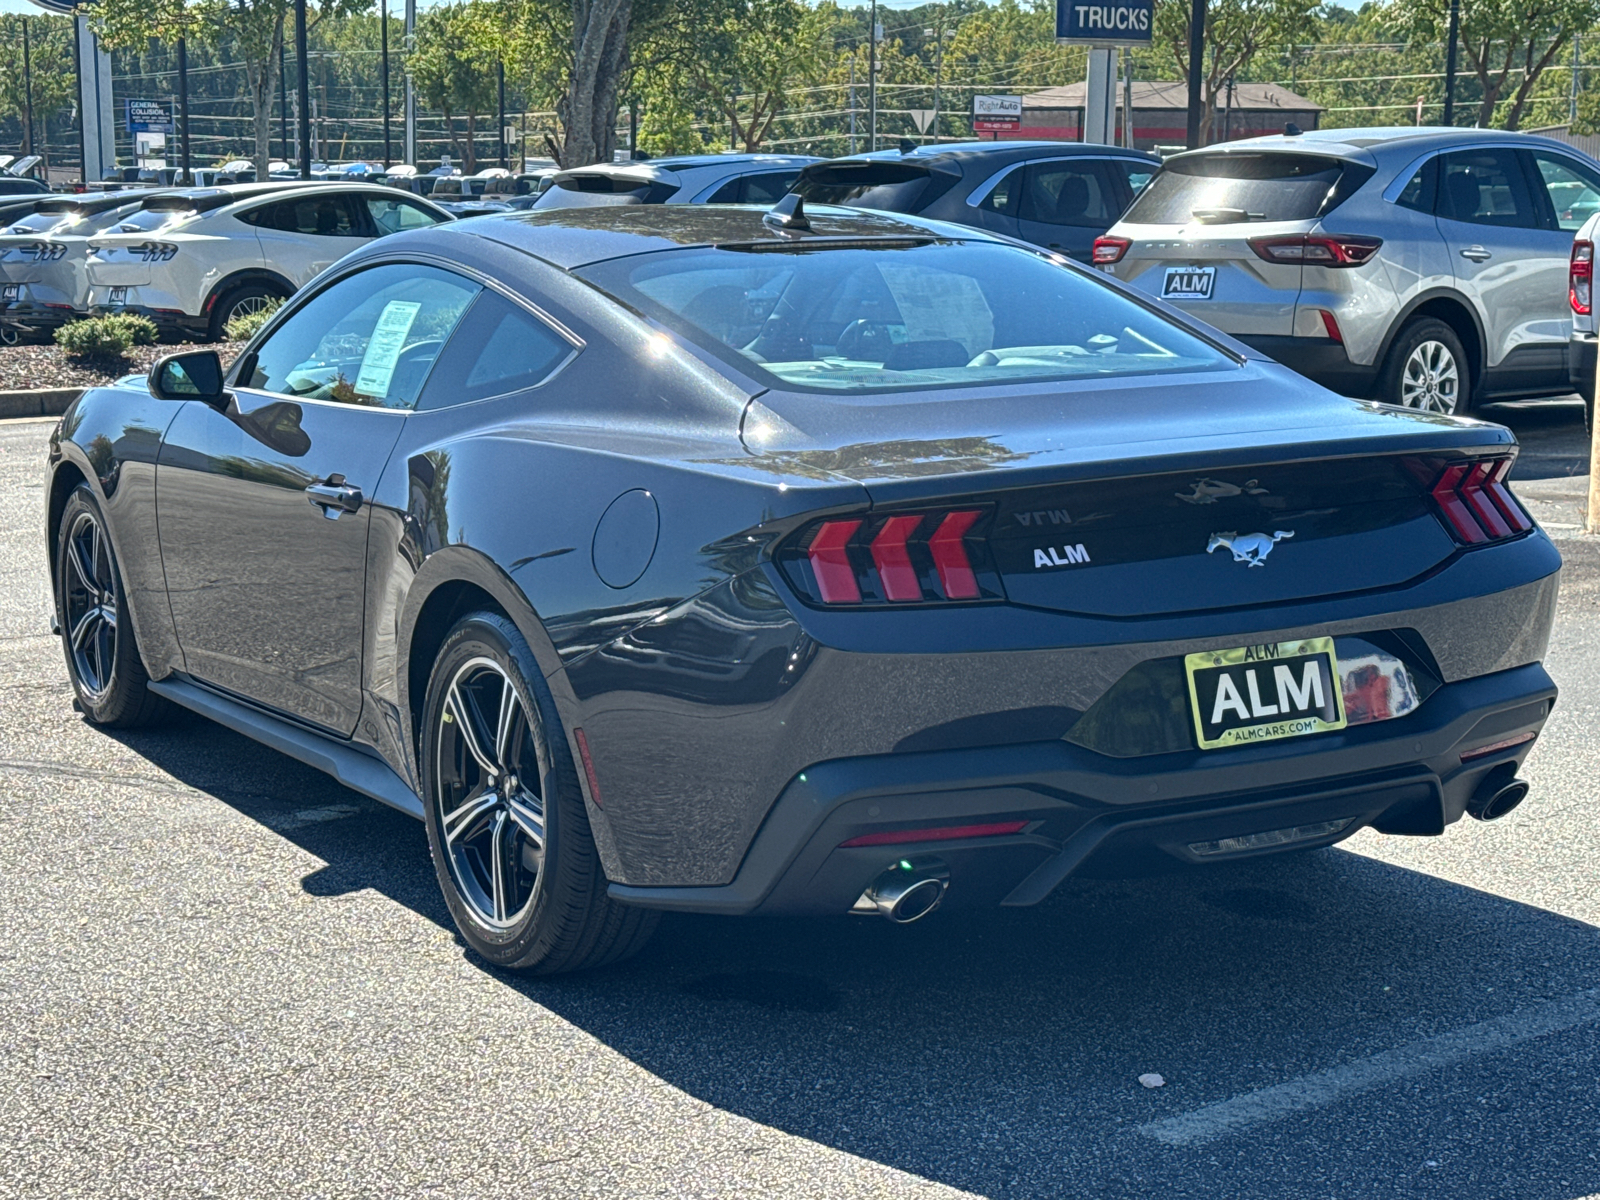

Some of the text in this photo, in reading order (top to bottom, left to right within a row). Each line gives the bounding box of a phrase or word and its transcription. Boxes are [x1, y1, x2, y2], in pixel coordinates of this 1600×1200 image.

[1075, 6, 1149, 31] TRUCKS
[4, 287, 17, 297] ALM
[1169, 275, 1209, 292] ALM
[111, 290, 124, 300] ALM
[1034, 544, 1091, 568] ALM
[1244, 643, 1280, 662] ALM
[1211, 660, 1325, 725] ALM
[1235, 720, 1313, 742] ALMCARS.COM
